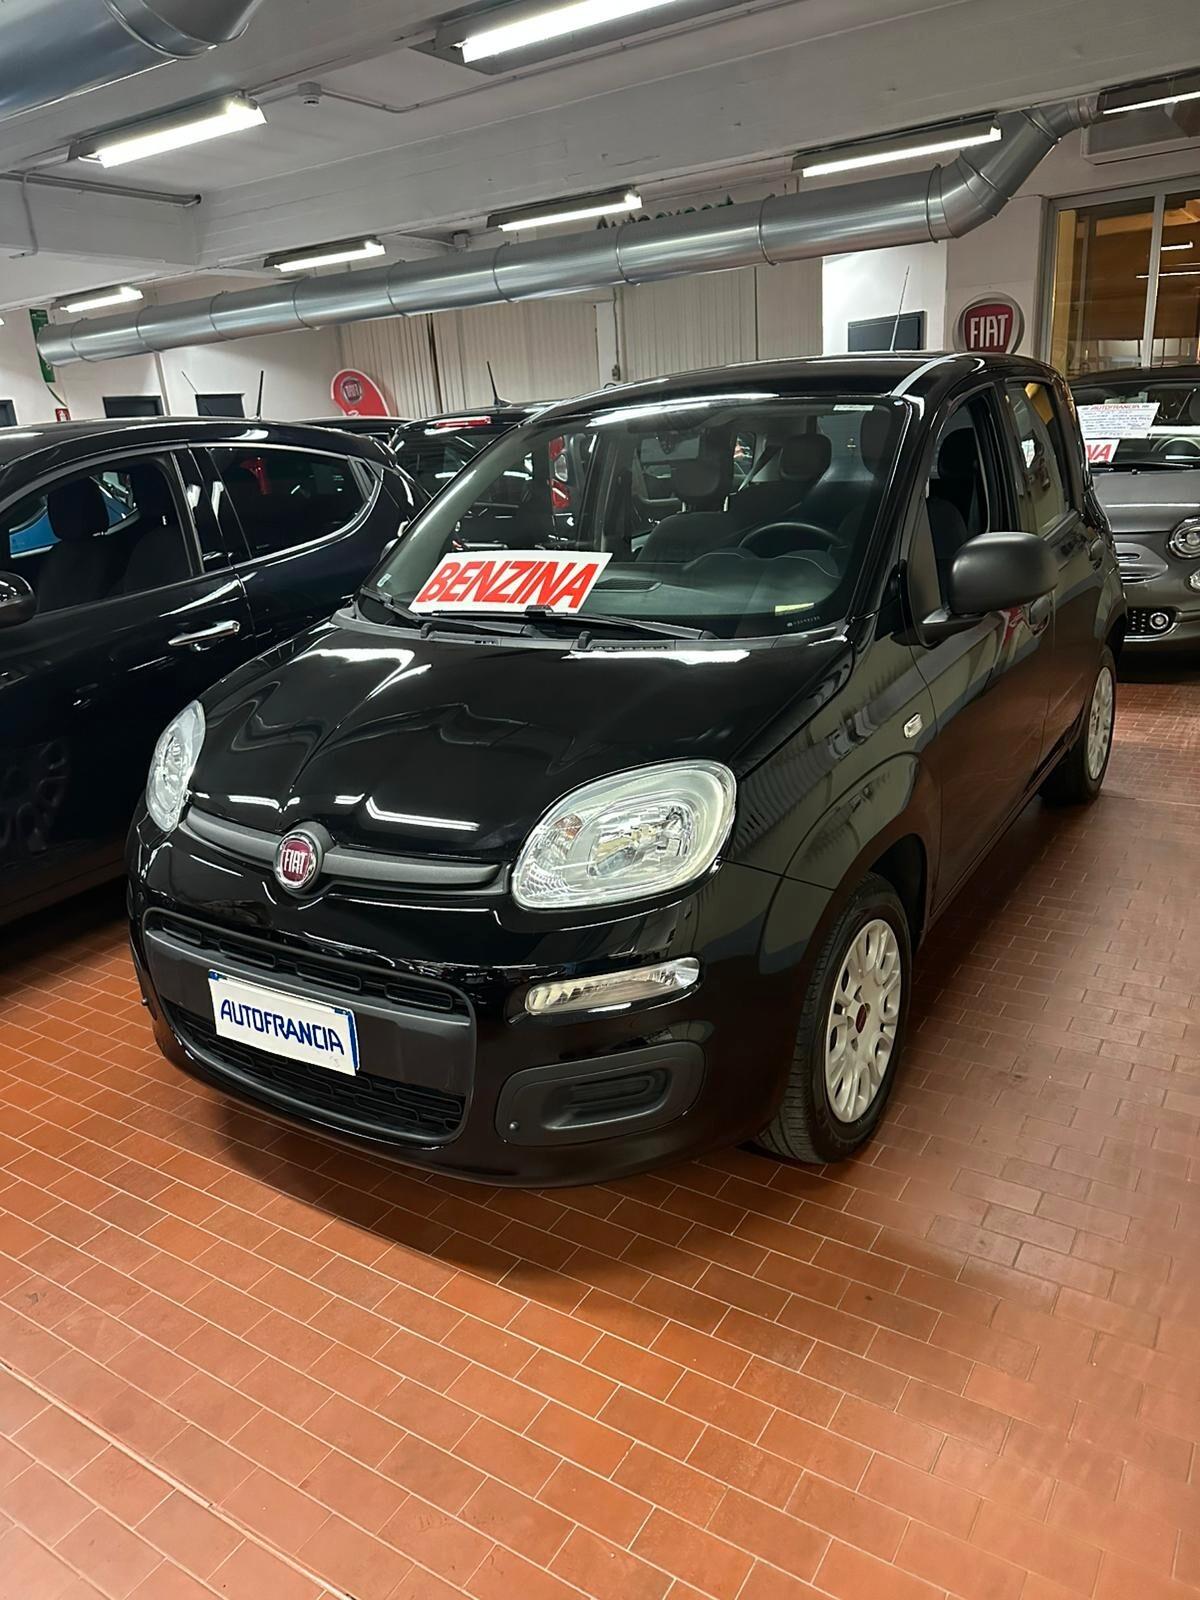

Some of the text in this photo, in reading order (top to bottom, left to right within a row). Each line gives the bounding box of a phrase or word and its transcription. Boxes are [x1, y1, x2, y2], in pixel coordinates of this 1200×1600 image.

[970, 314, 1008, 349] FIAT
[415, 561, 599, 608] BENZINA
[284, 849, 308, 874] FIAT
[220, 999, 345, 1055] AUTOFRANCIA
